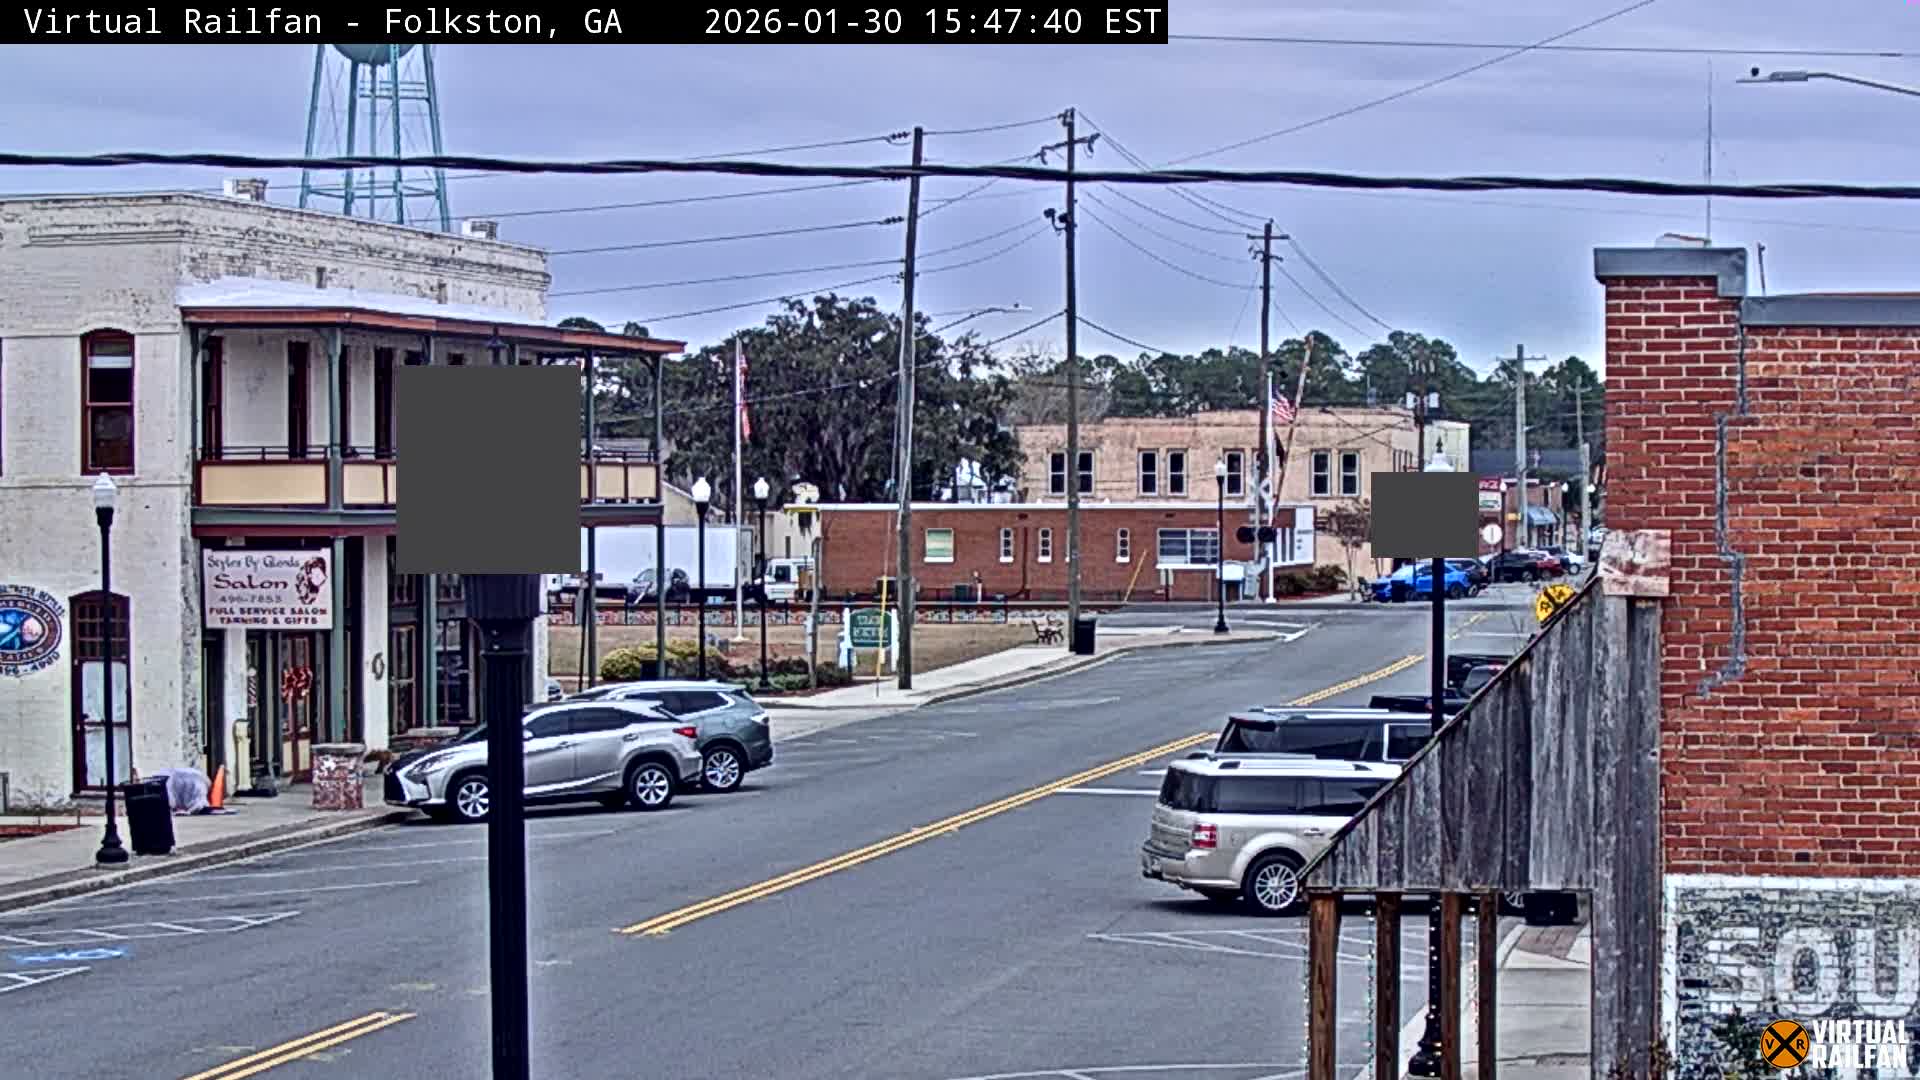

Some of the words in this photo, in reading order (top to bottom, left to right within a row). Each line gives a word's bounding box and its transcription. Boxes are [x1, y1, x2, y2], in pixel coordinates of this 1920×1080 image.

[213, 573, 288, 589] Salon
[209, 607, 235, 615] FULL
[240, 607, 286, 615] SERVICE
[291, 607, 327, 615] SALON
[220, 617, 268, 625] TANNING
[272, 617, 280, 625] &
[284, 617, 318, 625] GIFTS
